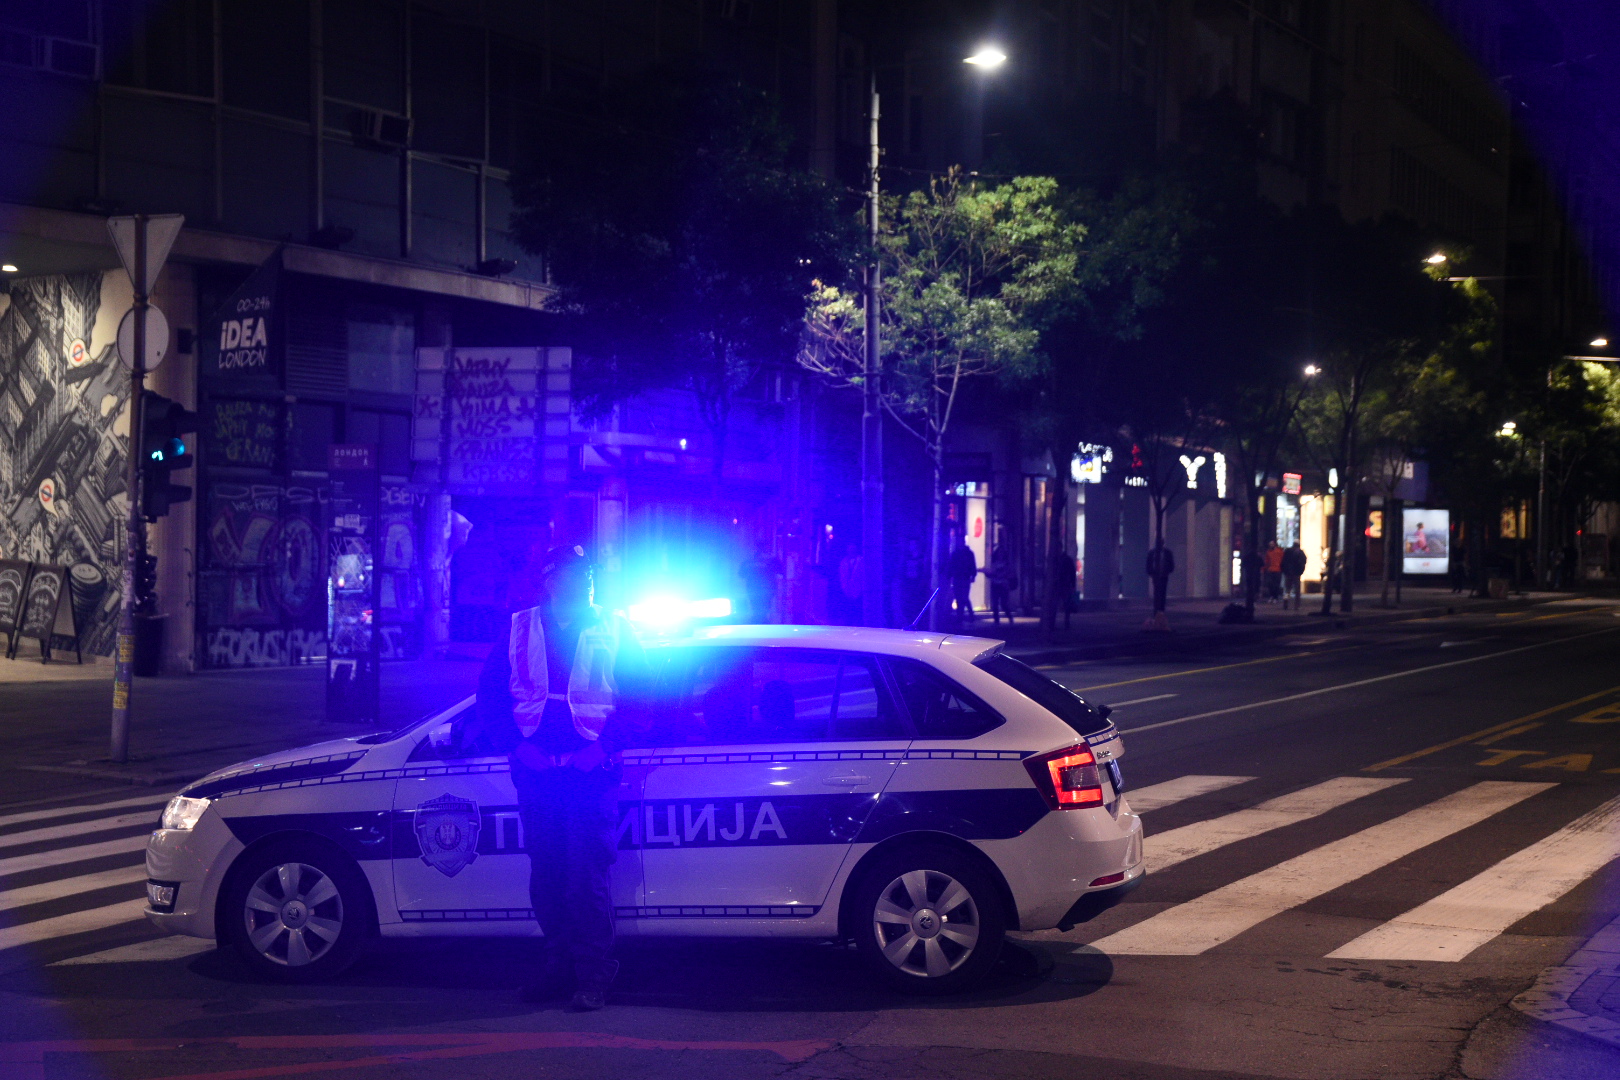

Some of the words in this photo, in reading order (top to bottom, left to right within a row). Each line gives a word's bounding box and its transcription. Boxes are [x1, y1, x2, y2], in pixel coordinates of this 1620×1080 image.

[218, 348, 266, 369] LONDON
[457, 417, 511, 437] MOSS
[495, 801, 788, 850] ПИЦИЈА
